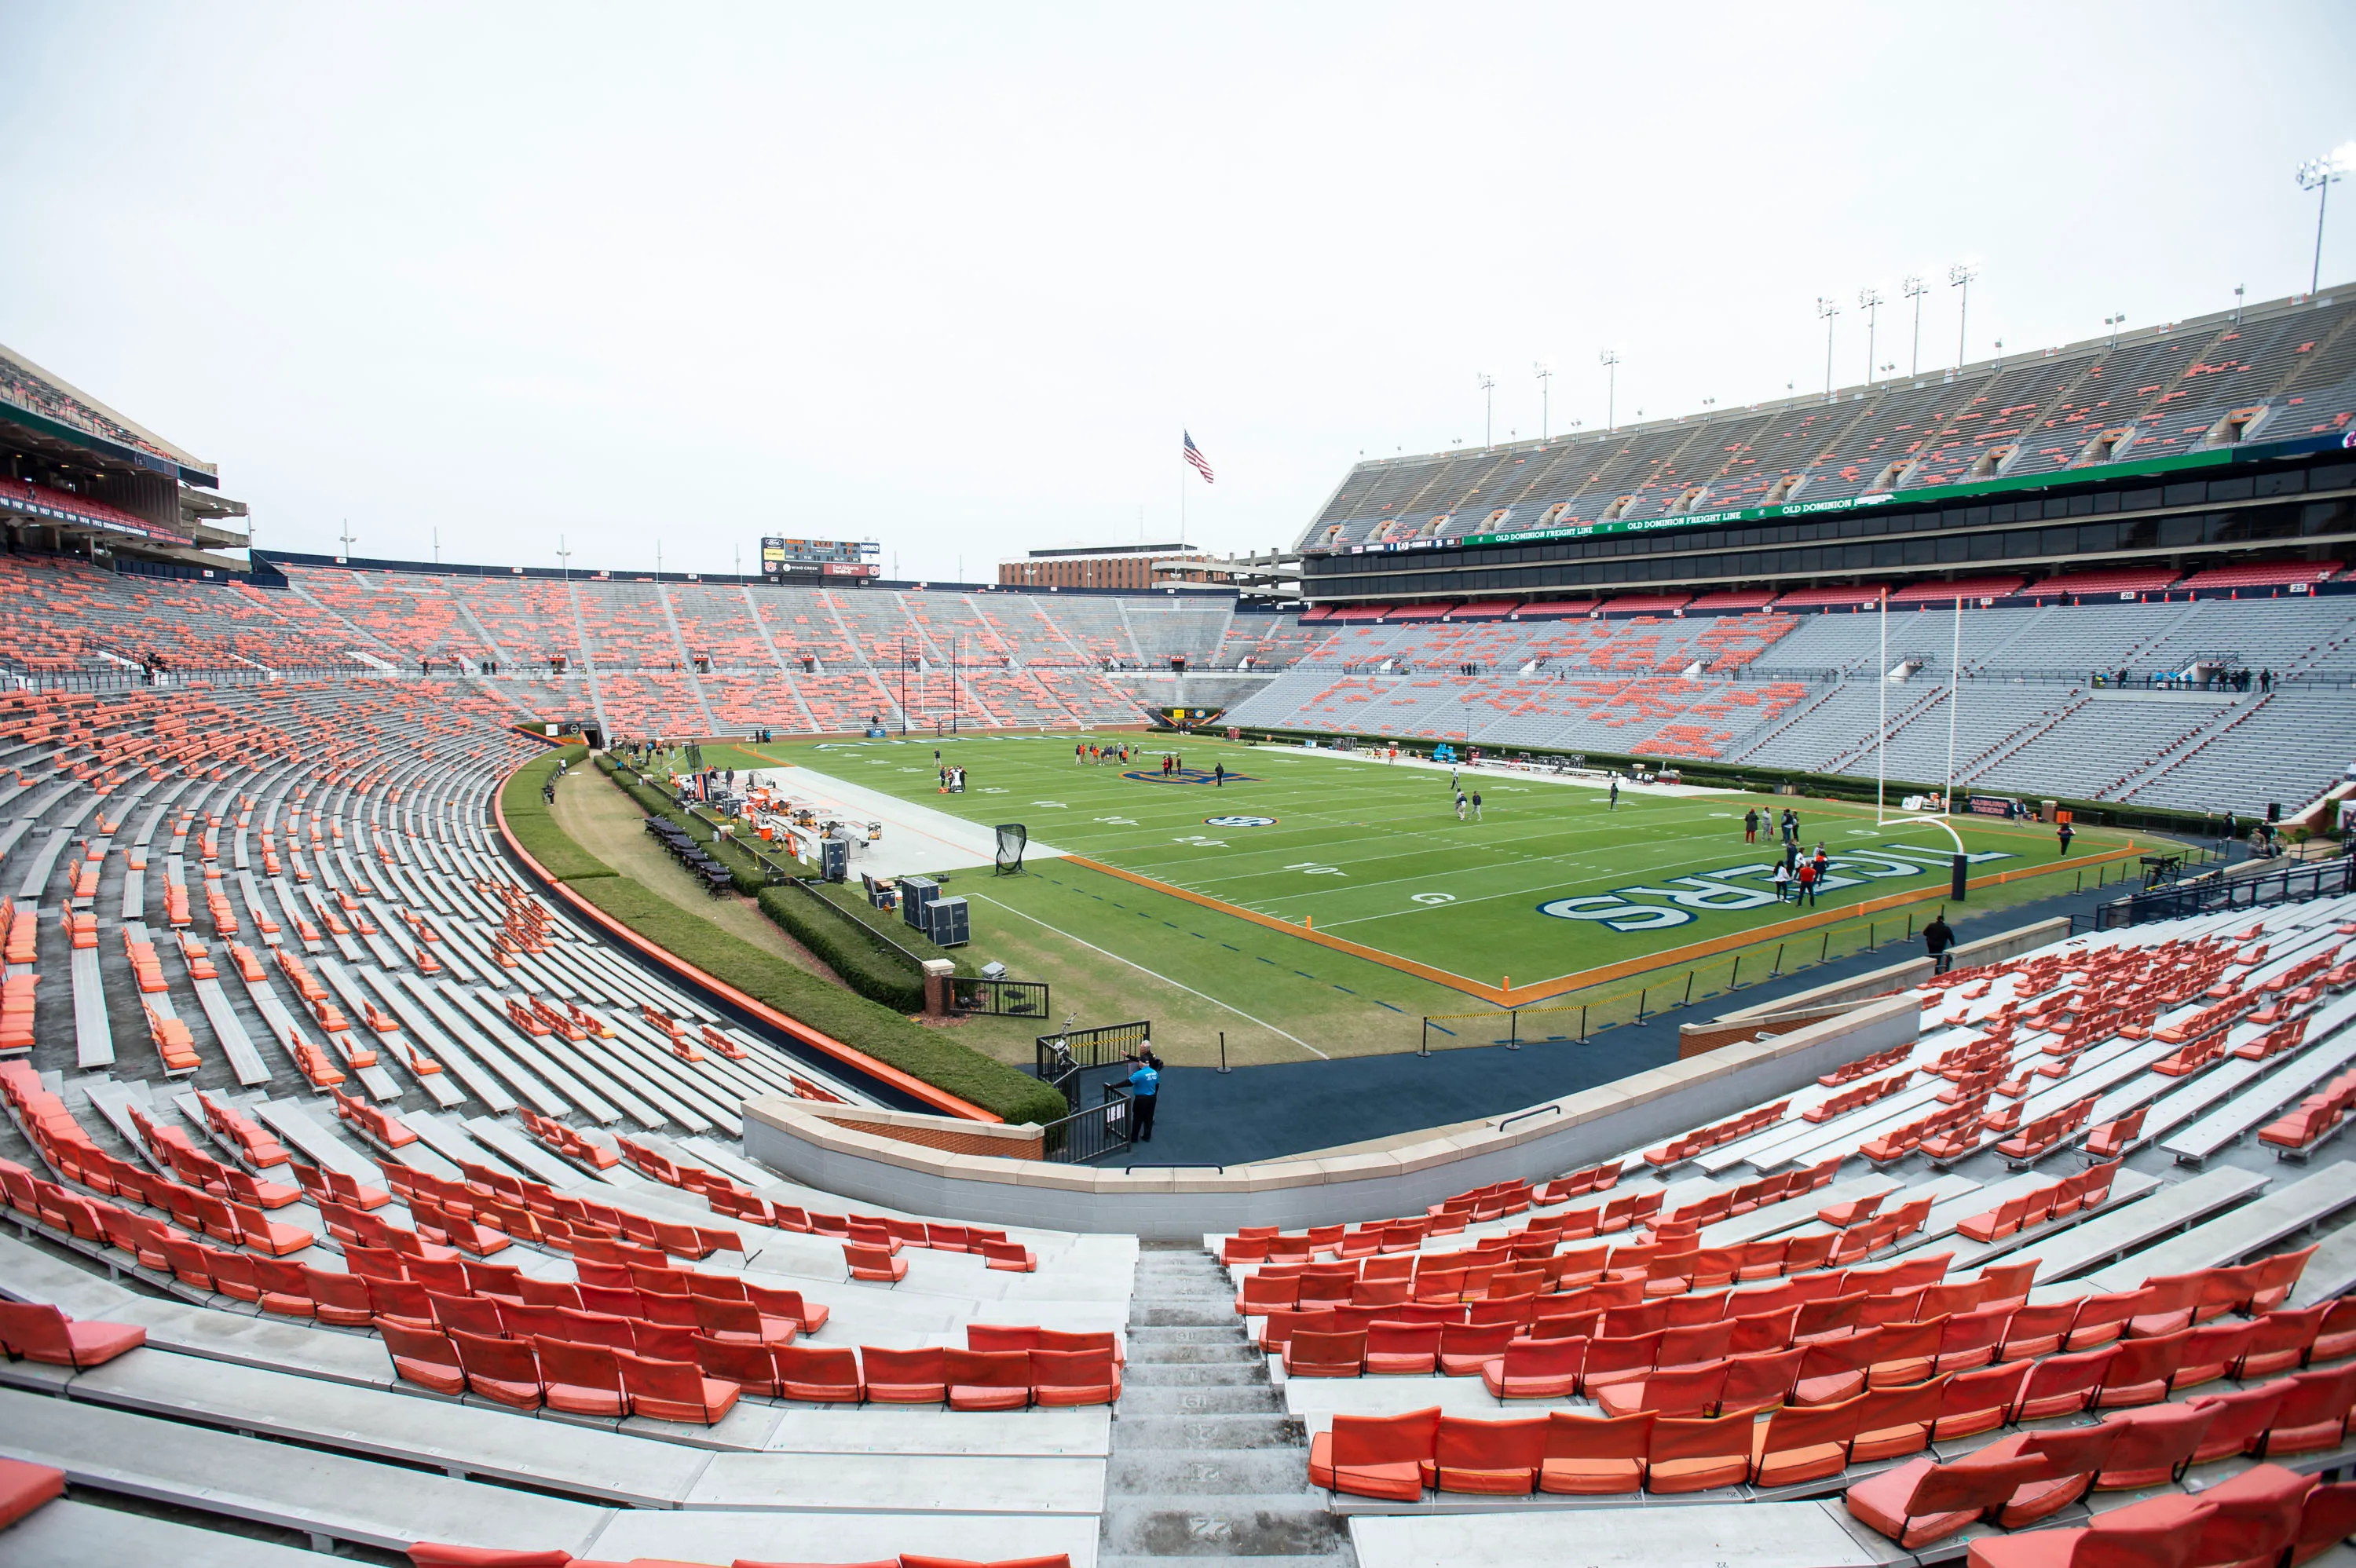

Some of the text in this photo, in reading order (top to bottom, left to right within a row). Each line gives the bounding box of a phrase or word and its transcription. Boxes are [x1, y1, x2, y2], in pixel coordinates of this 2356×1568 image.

[1783, 506, 1801, 514] OLD
[1803, 499, 1852, 512] DOMINION
[1628, 521, 1644, 530] OLD
[1644, 517, 1685, 528] DOMINION
[1687, 514, 1721, 524] FREIGHT
[1511, 532, 1545, 541] DOMINION
[1546, 528, 1576, 537] FREIGHT
[1970, 799, 2008, 809] AUBURN
[1972, 806, 2005, 815] TIGERS
[1410, 893, 1456, 905] G
[1189, 1517, 1233, 1537] 22
